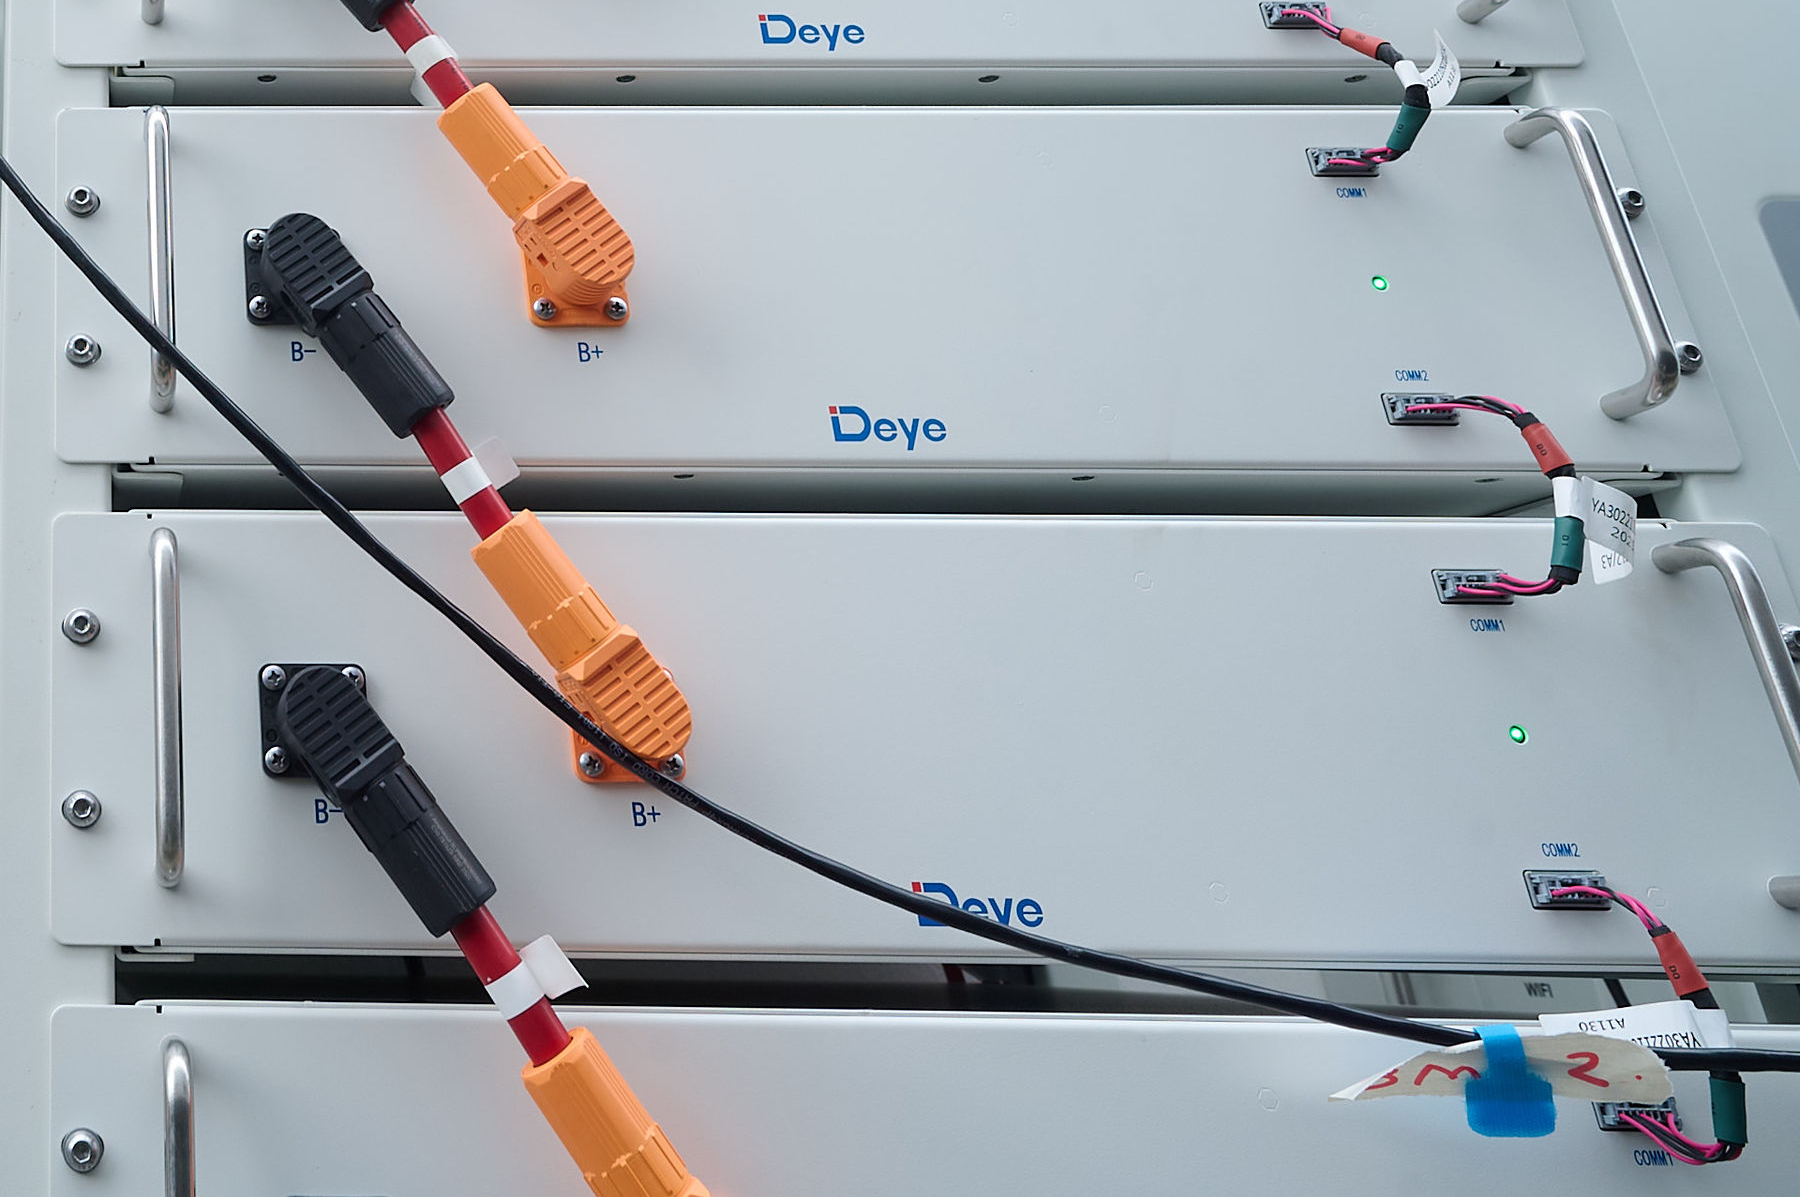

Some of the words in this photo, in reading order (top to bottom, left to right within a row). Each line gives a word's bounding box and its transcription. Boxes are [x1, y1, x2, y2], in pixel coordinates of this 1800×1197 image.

[757, 13, 866, 52] Deye
[1335, 187, 1368, 199] COMM1
[290, 340, 318, 363] B-
[577, 341, 604, 363] B+
[1394, 369, 1429, 382] COMM2
[828, 405, 948, 452] Deye
[1469, 618, 1506, 633] COMM1
[313, 798, 344, 825] B-
[631, 801, 662, 828] B+
[1541, 842, 1580, 858] COMM2
[1523, 981, 1554, 998] WIFI
[1578, 1017, 1625, 1033] A1130
[1633, 1149, 1675, 1167] COMM1
